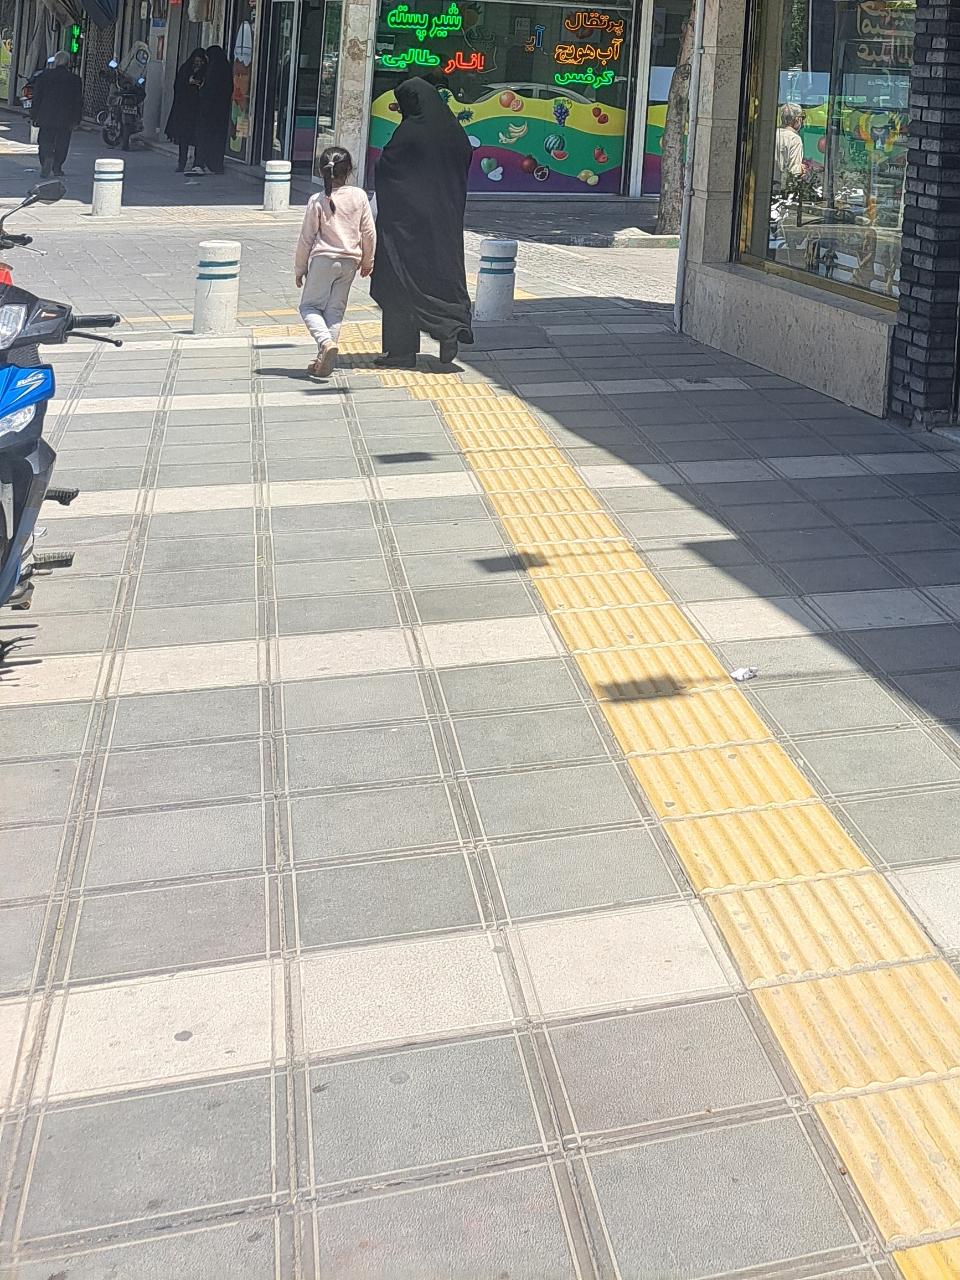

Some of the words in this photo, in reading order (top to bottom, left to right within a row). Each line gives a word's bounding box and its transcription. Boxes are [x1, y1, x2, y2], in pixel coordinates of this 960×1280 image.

[388, 5, 429, 41] پسته
[429, 3, 462, 37] شیر
[565, 12, 623, 36] پرتقال
[381, 48, 440, 68] طالبی
[444, 52, 484, 73] انار
[555, 44, 596, 65] هویج
[597, 38, 623, 66] آب
[554, 67, 615, 88] کرفس
